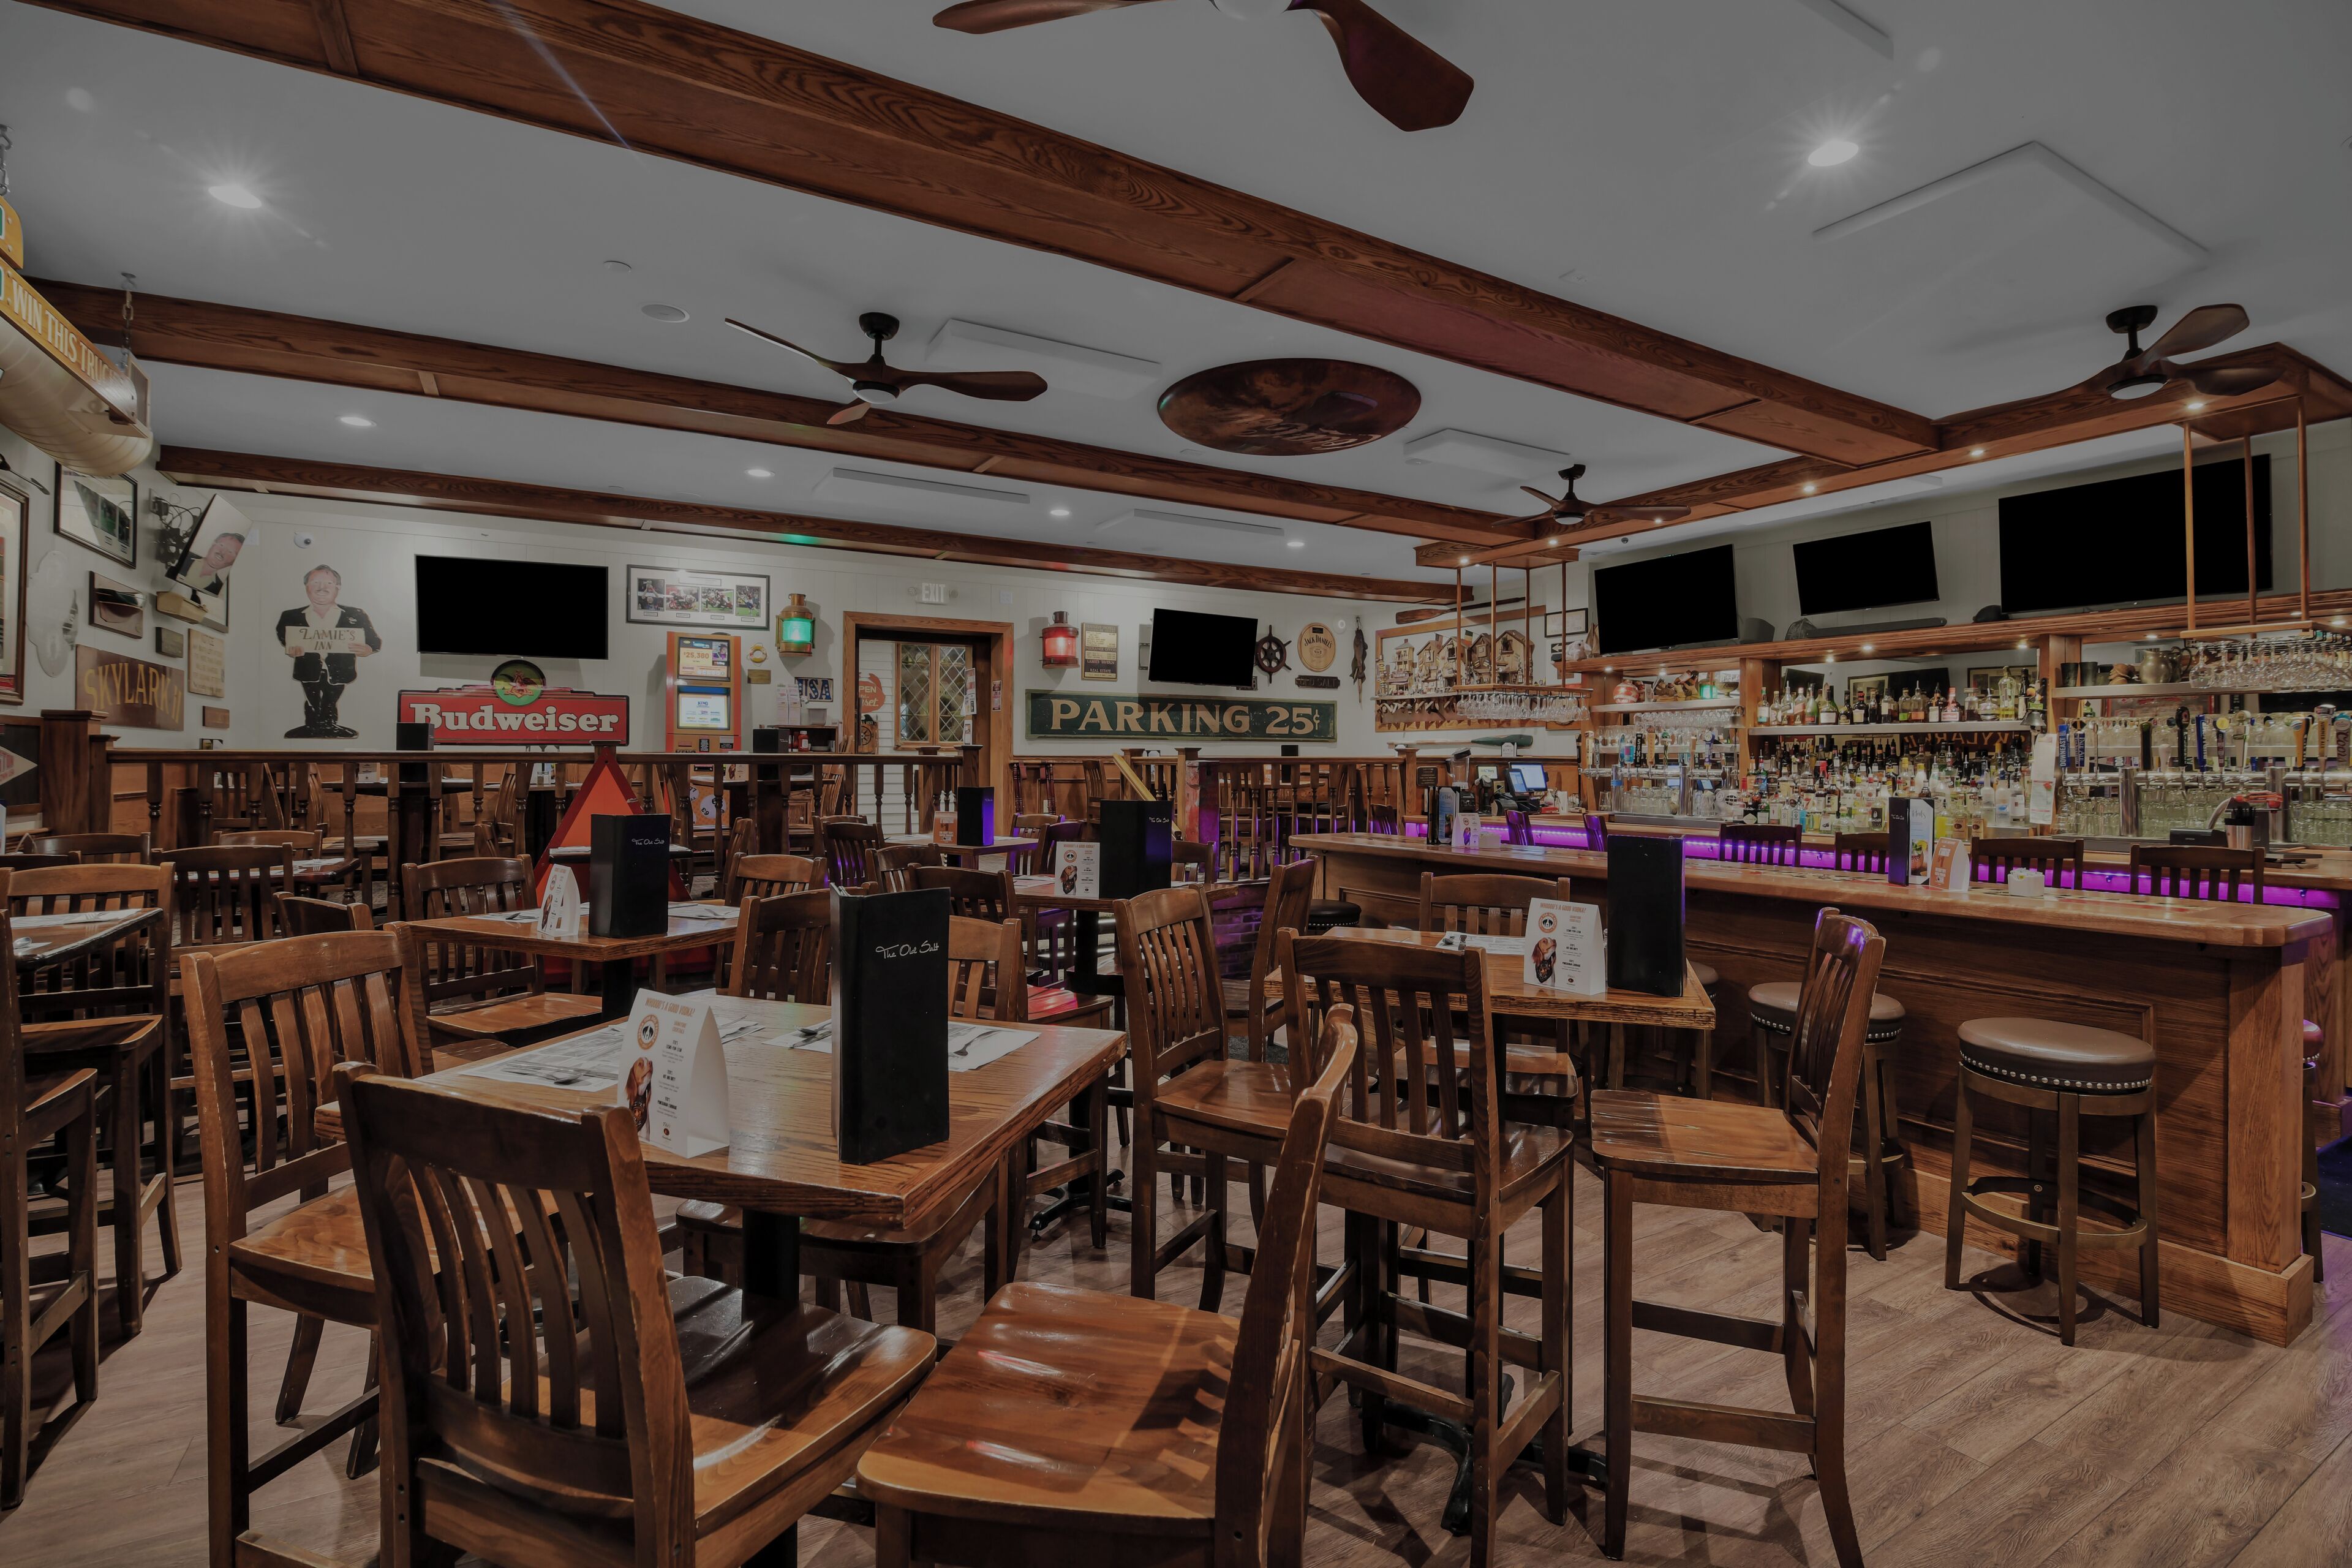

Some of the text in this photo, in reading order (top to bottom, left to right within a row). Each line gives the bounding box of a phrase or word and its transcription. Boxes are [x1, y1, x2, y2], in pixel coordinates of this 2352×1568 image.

[11, 278, 42, 335] WIN
[45, 309, 78, 363] THIS
[922, 582, 946, 602] EXIT
[299, 628, 355, 641] LAMIE'S
[1305, 635, 1333, 649] JACK DANIEL'S
[314, 641, 333, 650] INN
[84, 662, 172, 715] SKYLARK
[797, 678, 832, 701] USA
[1317, 679, 1336, 688] SALT
[409, 703, 619, 732] Budweiser
[1050, 698, 1250, 734] PARKING
[875, 940, 940, 959] The Old Salt
[668, 1002, 680, 1014] GOOD
[679, 1005, 695, 1017] VODKA?
